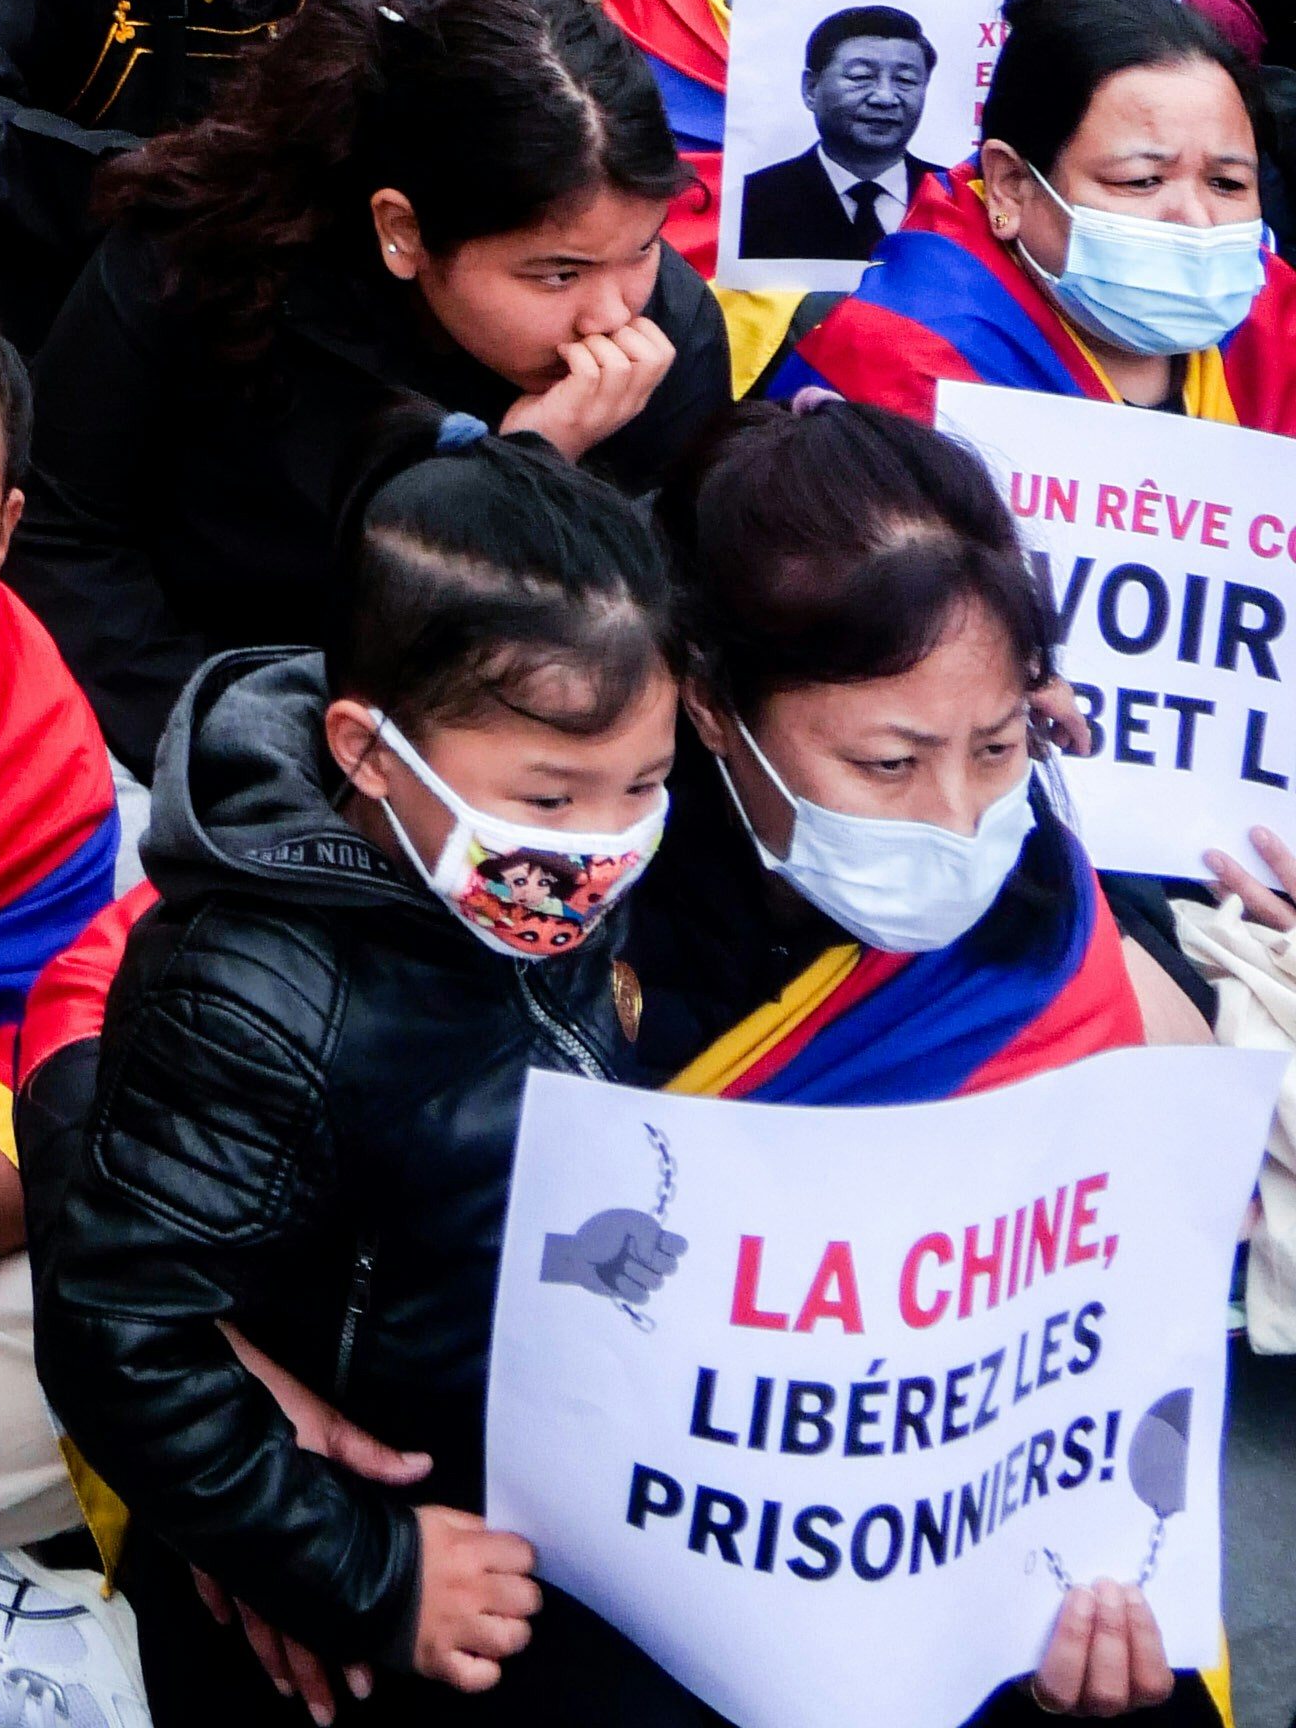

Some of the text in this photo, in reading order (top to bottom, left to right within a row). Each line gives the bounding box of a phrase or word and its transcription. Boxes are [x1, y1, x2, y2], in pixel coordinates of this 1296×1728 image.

[1010, 471, 1080, 525] UN
[1096, 478, 1234, 552] RÊVE
[1030, 550, 1288, 683] VOIR
[729, 1171, 1122, 1336] LA CHINE,
[689, 1301, 1107, 1460] LIBÉREZ LES
[625, 1409, 1124, 1583] PRISONNIERS!
